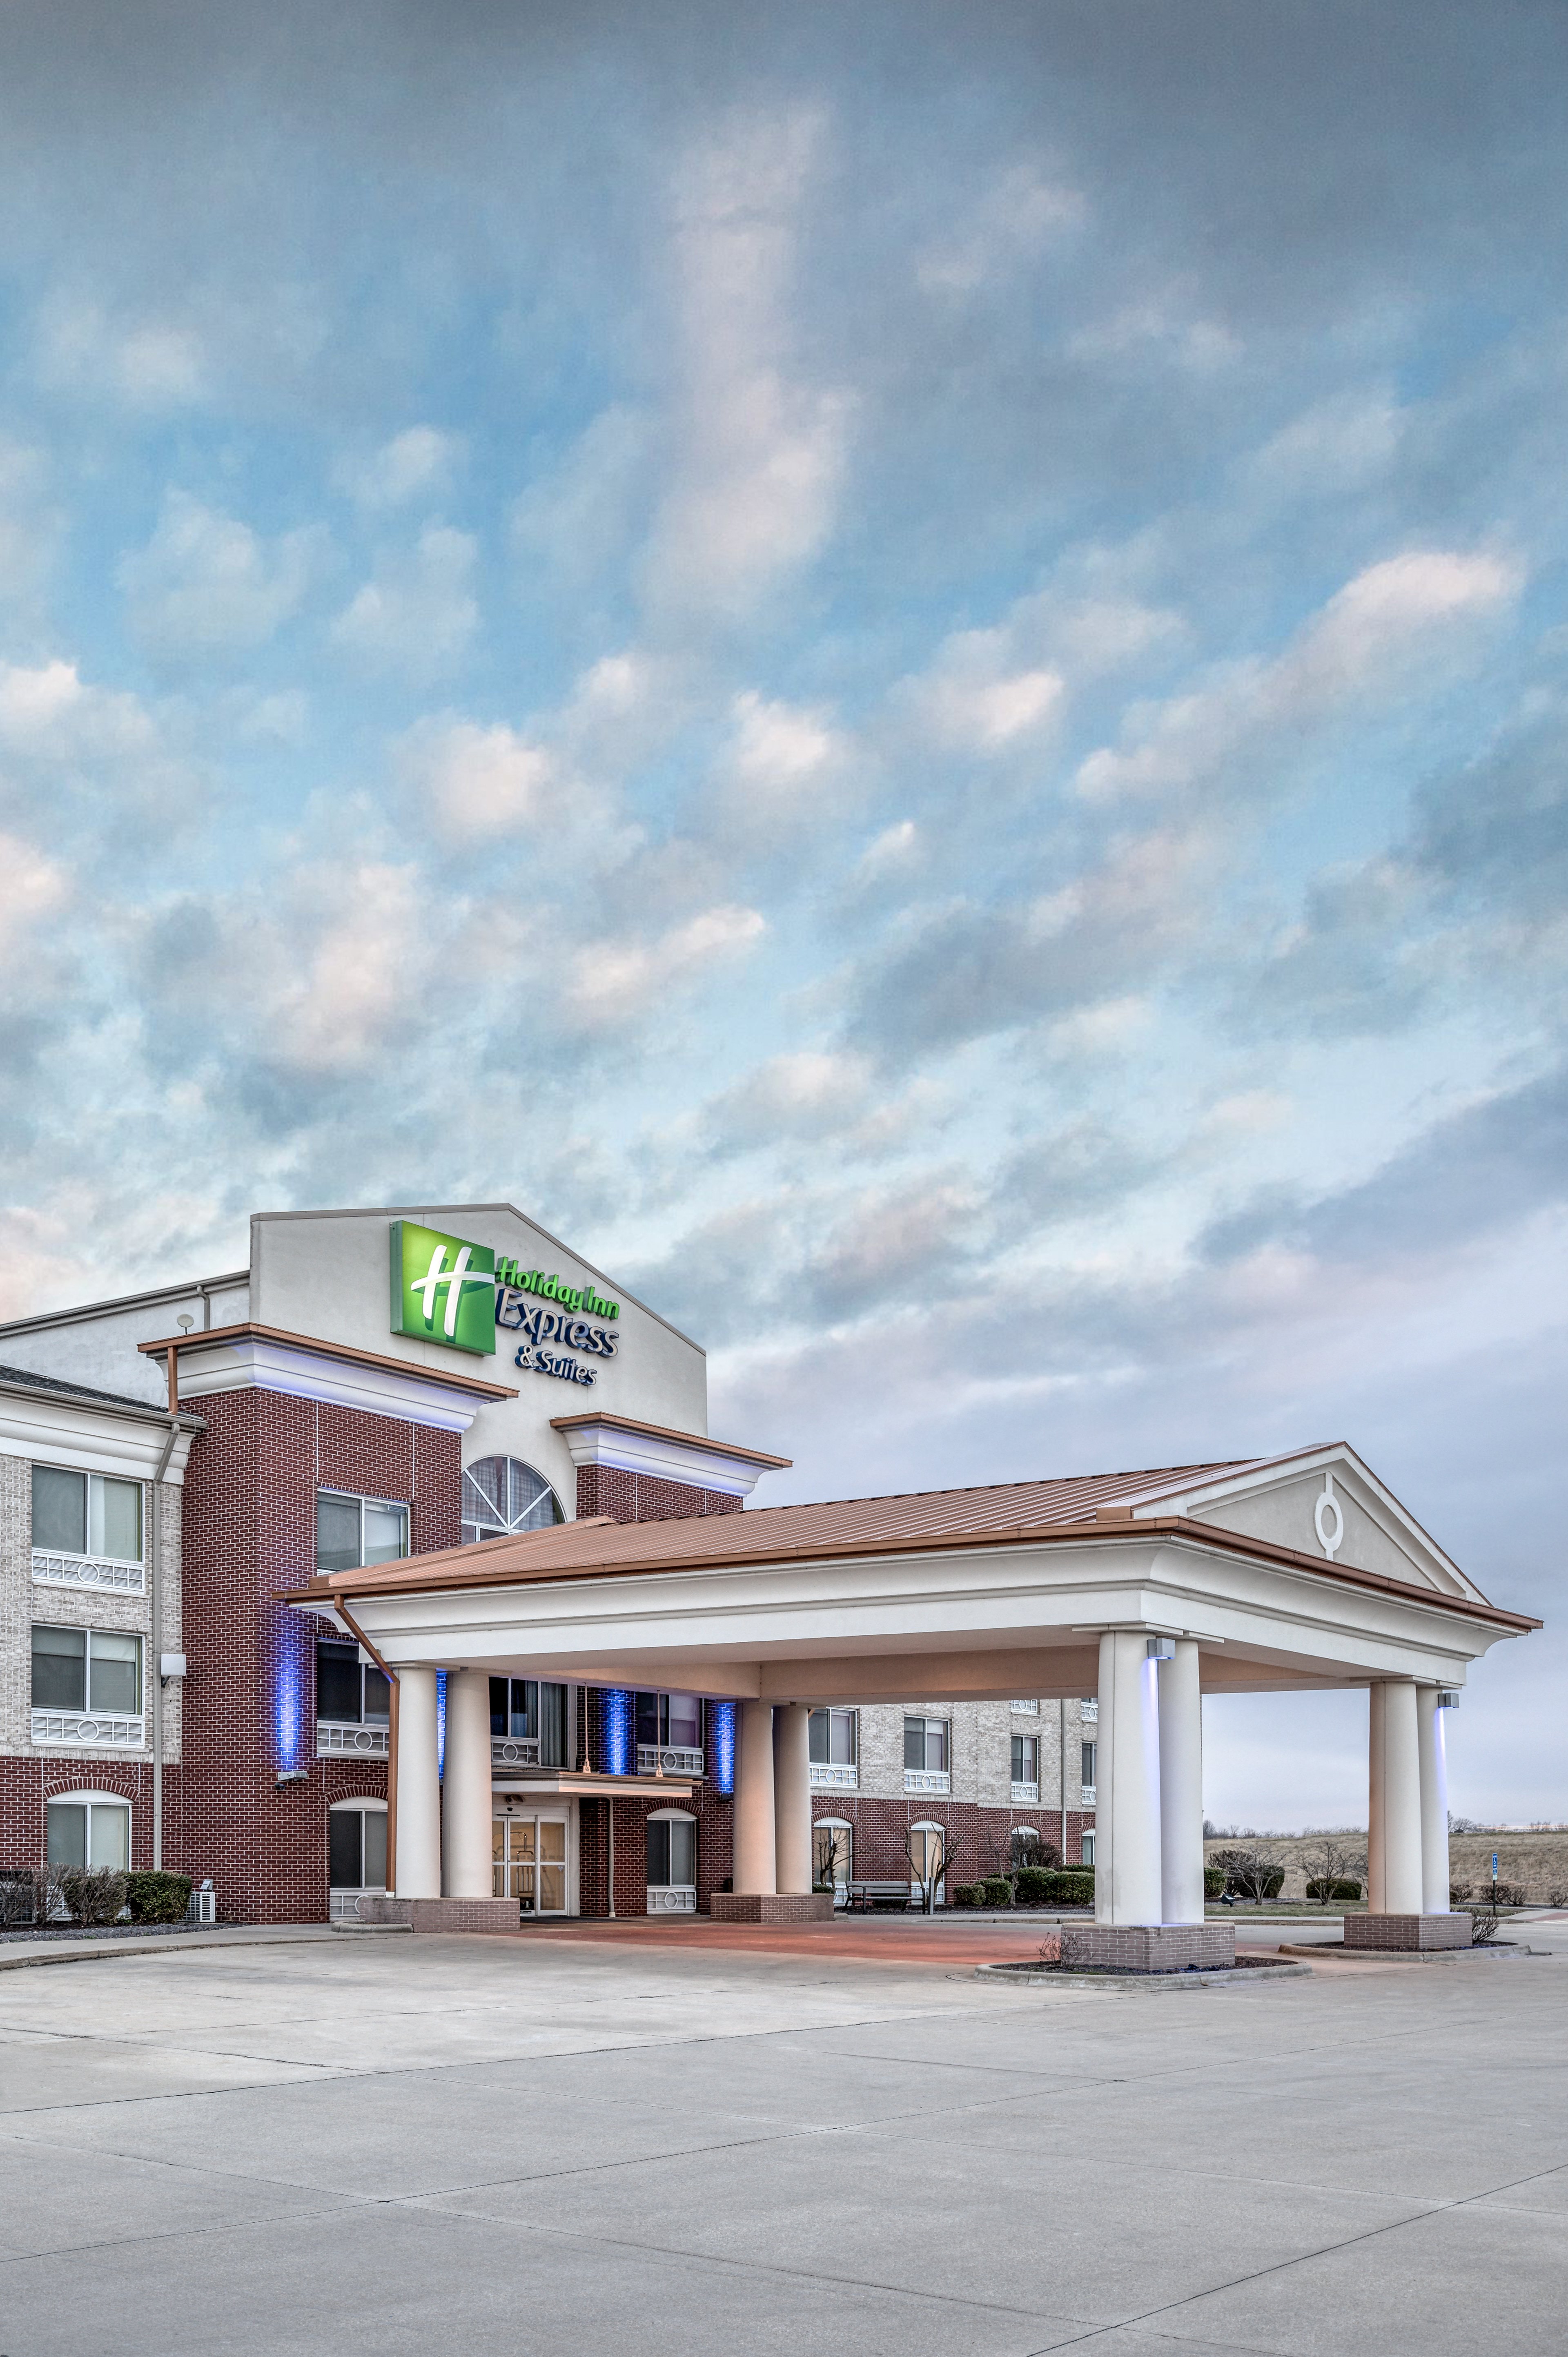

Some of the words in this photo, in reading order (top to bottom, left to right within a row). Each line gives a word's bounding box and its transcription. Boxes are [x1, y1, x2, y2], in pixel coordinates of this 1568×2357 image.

[495, 1256, 584, 1313] Holiday
[582, 1286, 620, 1320] Inn
[495, 1288, 619, 1358] Express
[514, 1345, 535, 1369] &
[534, 1350, 597, 1386] Suites
